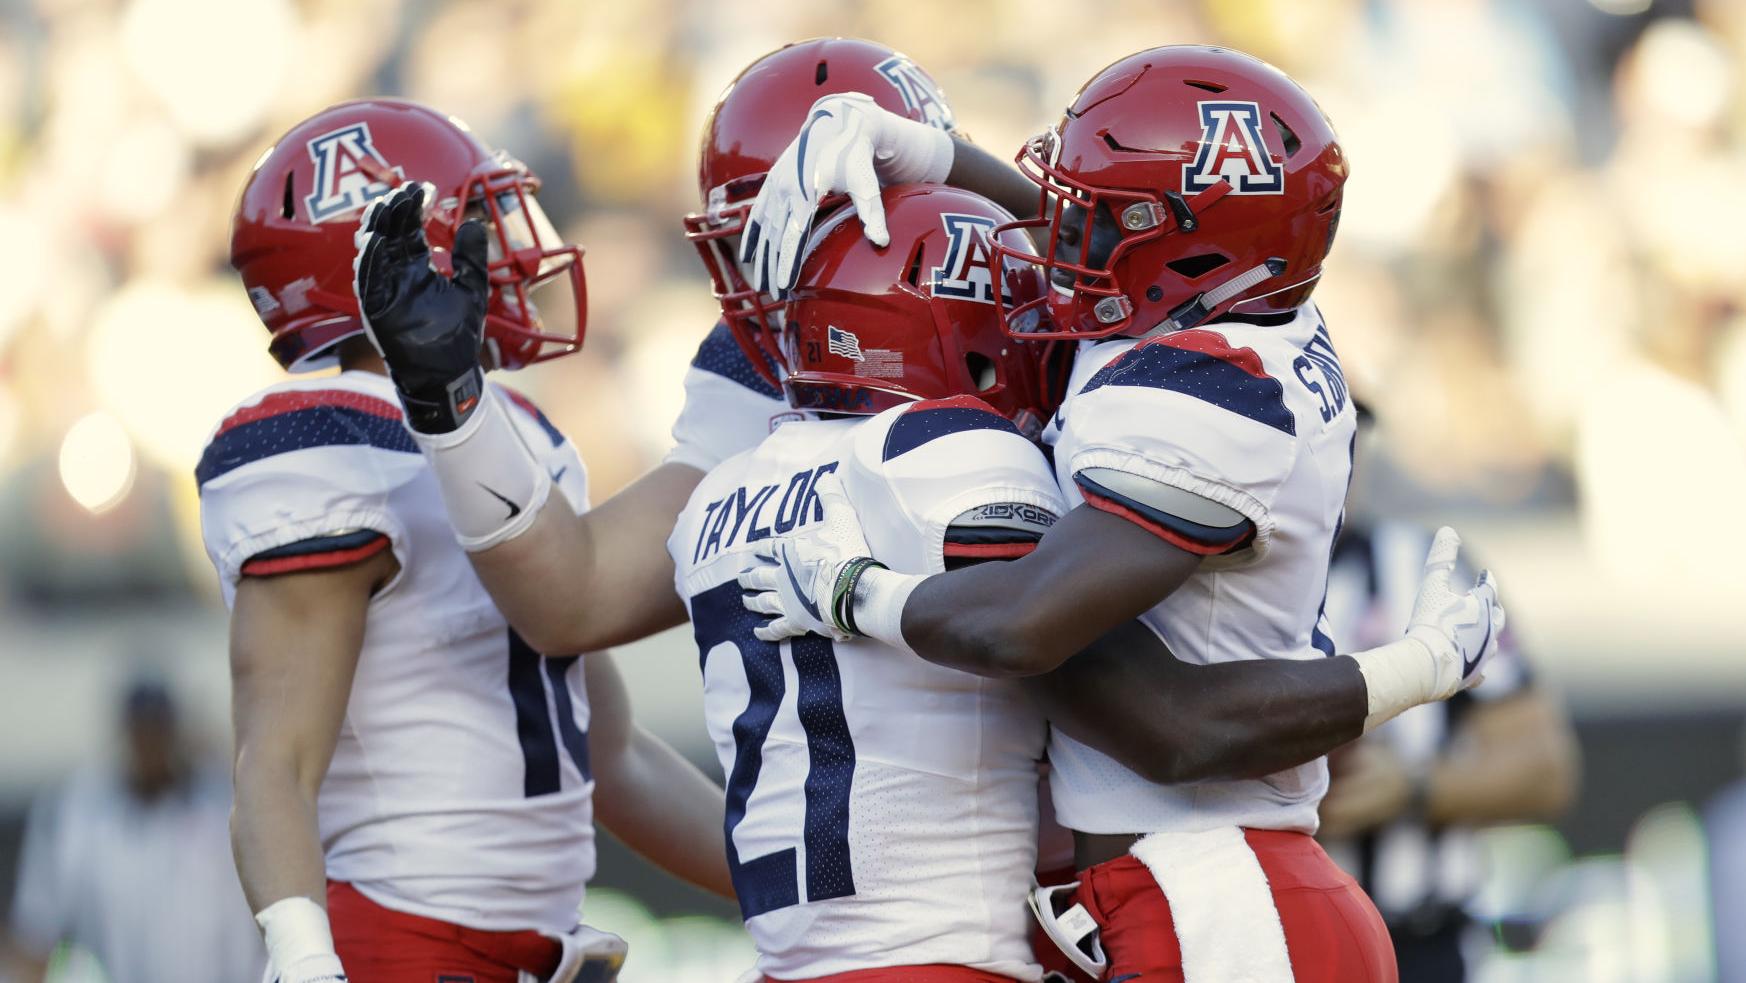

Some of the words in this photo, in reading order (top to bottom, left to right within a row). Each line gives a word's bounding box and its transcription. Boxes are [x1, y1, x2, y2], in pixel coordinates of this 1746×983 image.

[304, 121, 406, 224] A
[1181, 100, 1285, 195] A
[931, 213, 1018, 309] A
[693, 461, 839, 565] TAYLOR
[690, 579, 857, 921] 21
